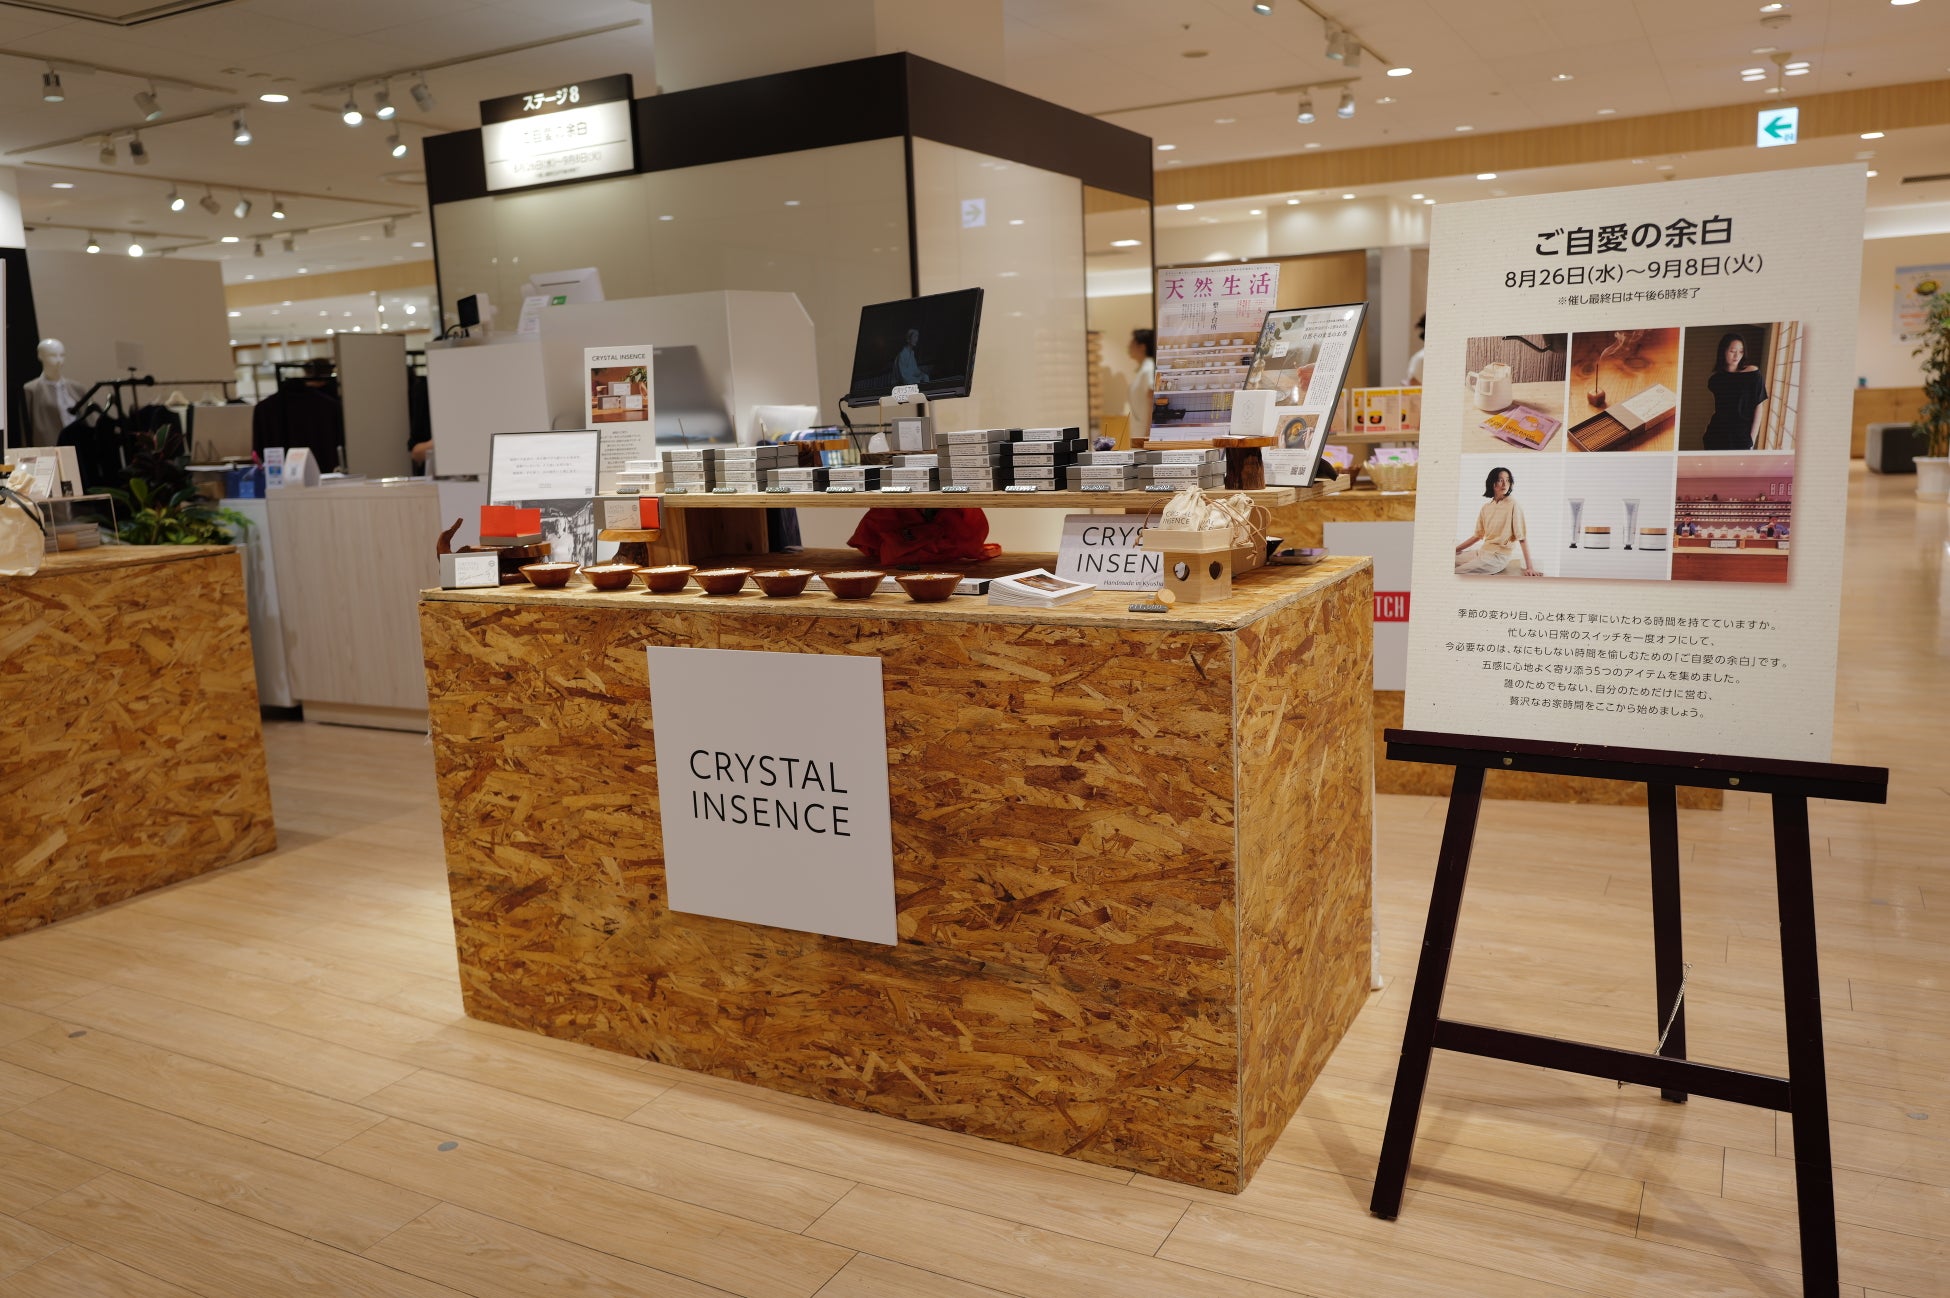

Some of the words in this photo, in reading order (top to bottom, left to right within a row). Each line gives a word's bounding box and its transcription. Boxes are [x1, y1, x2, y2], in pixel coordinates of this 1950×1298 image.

[523, 86, 580, 111] ステージ8
[1536, 215, 1732, 256] ご自愛の余白
[1504, 253, 1763, 288] 8月26日(水)〜9月8日(火)
[1164, 272, 1271, 300] 天然生活
[1558, 287, 1700, 306] ※催し最終日は午後6時終了
[592, 354, 618, 362] CRYSTAL
[1508, 627, 1715, 647] 忙しない日常のスイッチを一度オフにして、
[1510, 695, 1704, 719] 贅沢なお家時間をここから始めましょう。
[690, 749, 848, 794] CRYSTAL
[692, 790, 851, 837] INSENCE
